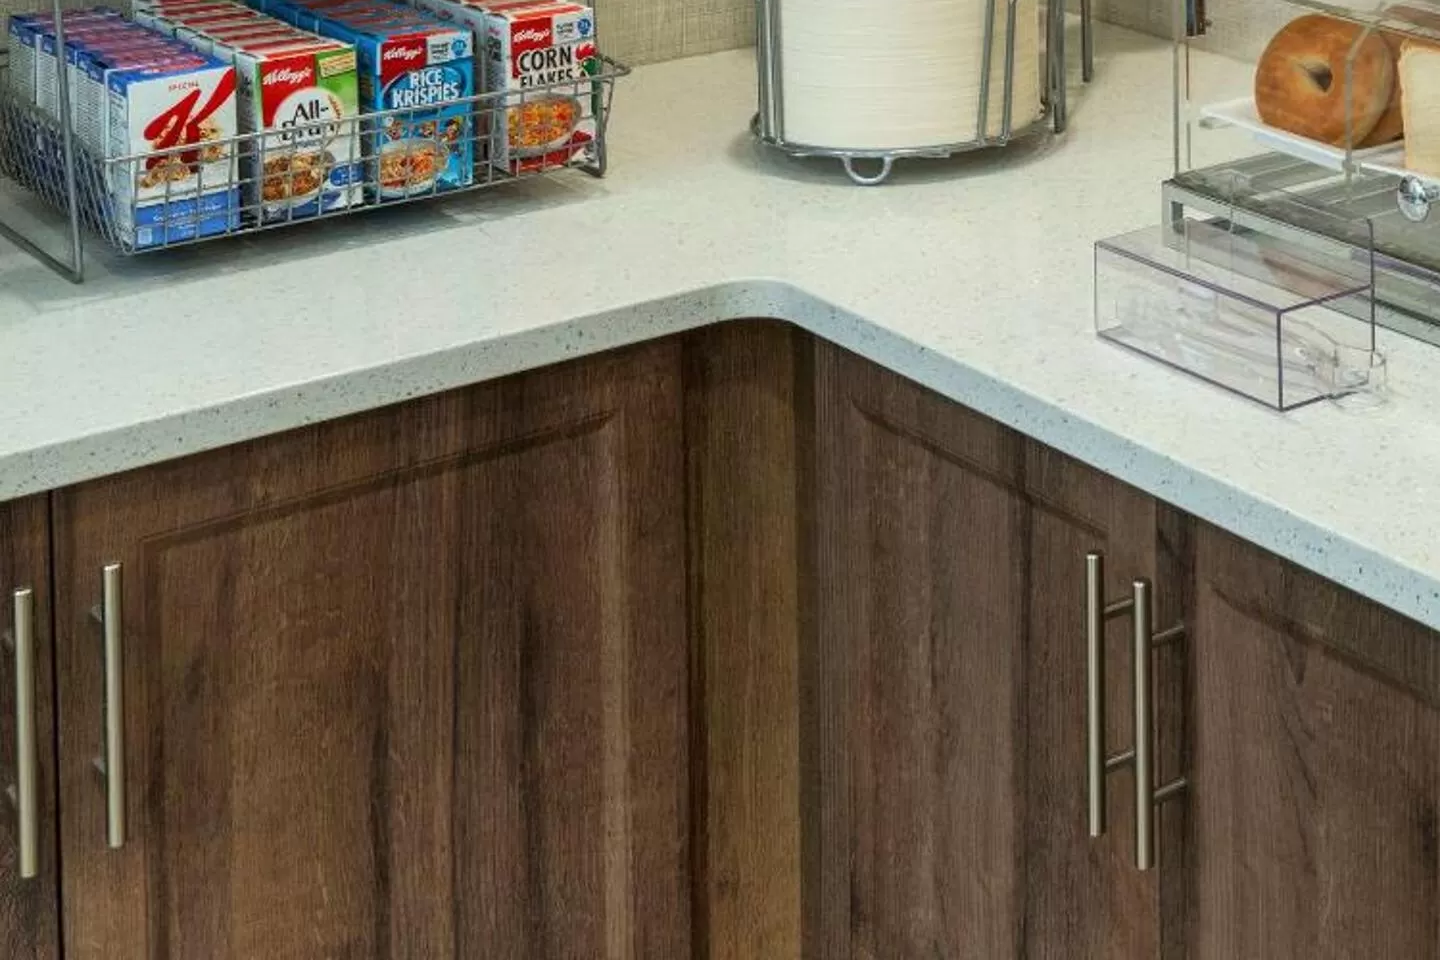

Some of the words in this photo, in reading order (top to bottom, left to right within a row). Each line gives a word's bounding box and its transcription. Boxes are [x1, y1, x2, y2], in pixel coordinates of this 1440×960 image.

[513, 28, 550, 42] Kellogg's
[384, 45, 423, 60] Kellogg's
[519, 45, 572, 72] CORN
[263, 67, 312, 85] Kellogg's
[409, 69, 442, 90] RICE
[393, 82, 460, 109] KRISPIES
